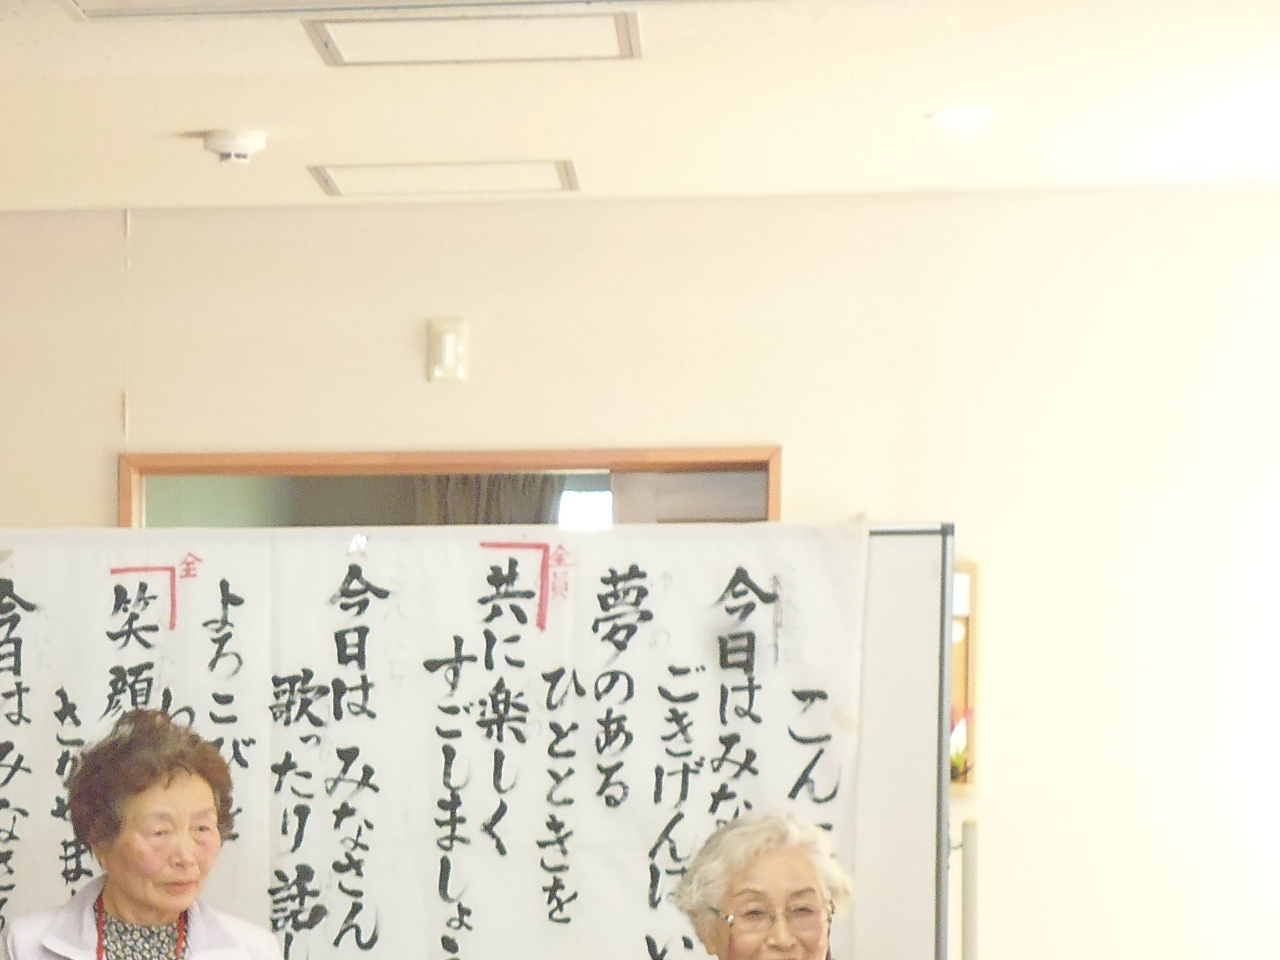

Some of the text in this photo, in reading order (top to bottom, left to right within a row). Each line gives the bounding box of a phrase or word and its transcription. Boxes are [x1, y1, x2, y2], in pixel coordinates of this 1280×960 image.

[180, 552, 203, 578] 全
[592, 564, 652, 807] 夢のある
[325, 564, 392, 951] 今日はみなさん
[476, 557, 535, 856] 共に楽しく
[537, 667, 586, 924] ひとときを
